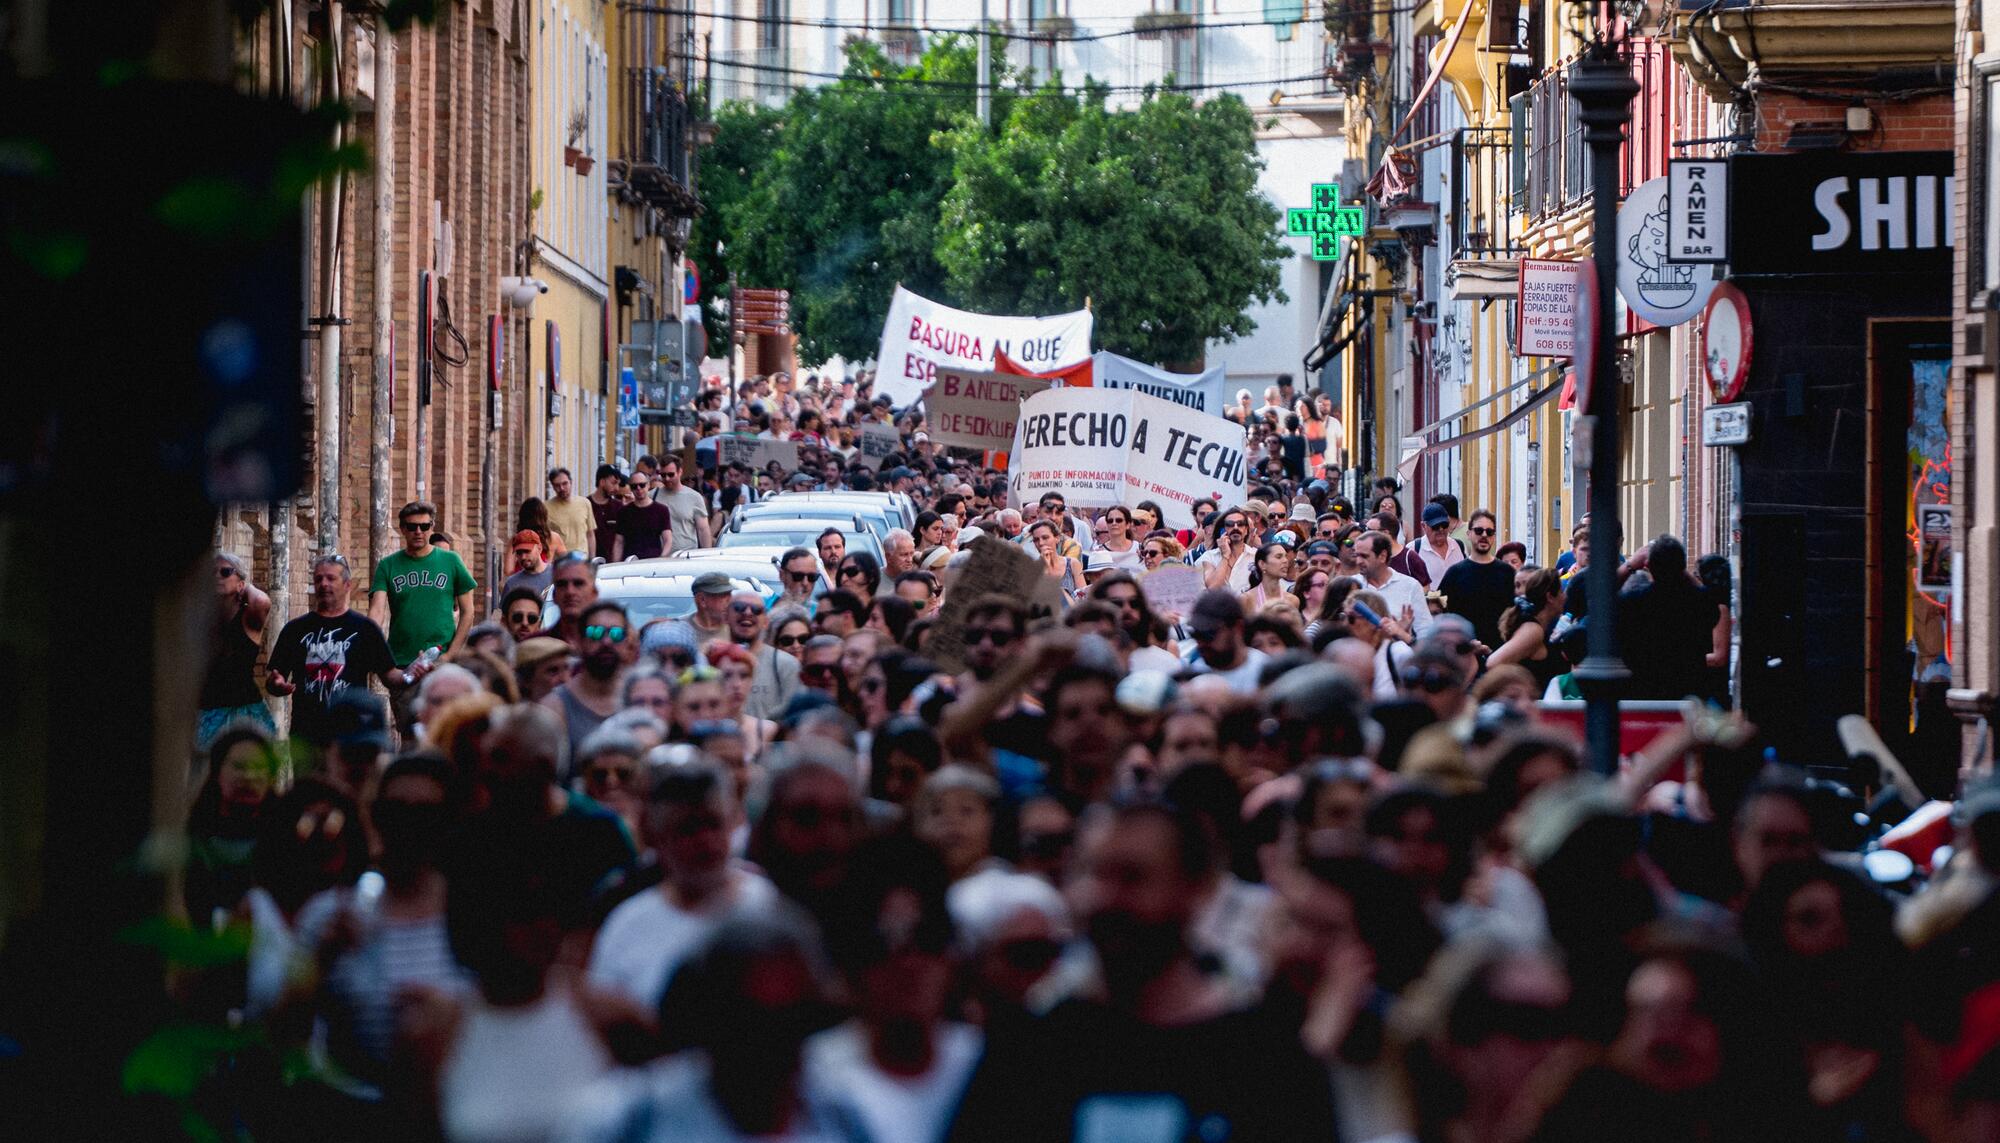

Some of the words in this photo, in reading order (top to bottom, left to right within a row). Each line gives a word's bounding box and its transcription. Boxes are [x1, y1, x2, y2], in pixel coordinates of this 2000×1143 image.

[1688, 167, 1706, 239] RAMEN
[1683, 246, 1713, 254] BAR
[1524, 262, 1560, 272] Hermanos
[1562, 264, 1579, 272] León
[1524, 282, 1545, 291] CAJAS
[1547, 283, 1576, 293] FUERTES
[1524, 292, 1567, 303] CERRADURAS
[1523, 303, 1547, 313] COPIAS
[1549, 304, 1557, 313] DE
[1548, 318, 1560, 327] 95
[909, 315, 983, 362] BASURA
[1022, 336, 1062, 362] QUE
[1536, 340, 1554, 349] 608
[944, 374, 1017, 401] BANCOS
[1132, 418, 1149, 454] A
[1163, 427, 1244, 487] TECHO
[1029, 471, 1050, 480] PUNTO
[1053, 470, 1062, 479] DE
[1065, 469, 1116, 480] INFORMACIÓN
[1144, 480, 1150, 489] Y
[1028, 481, 1062, 489] DIAMANTINO
[393, 570, 448, 592] POLO
